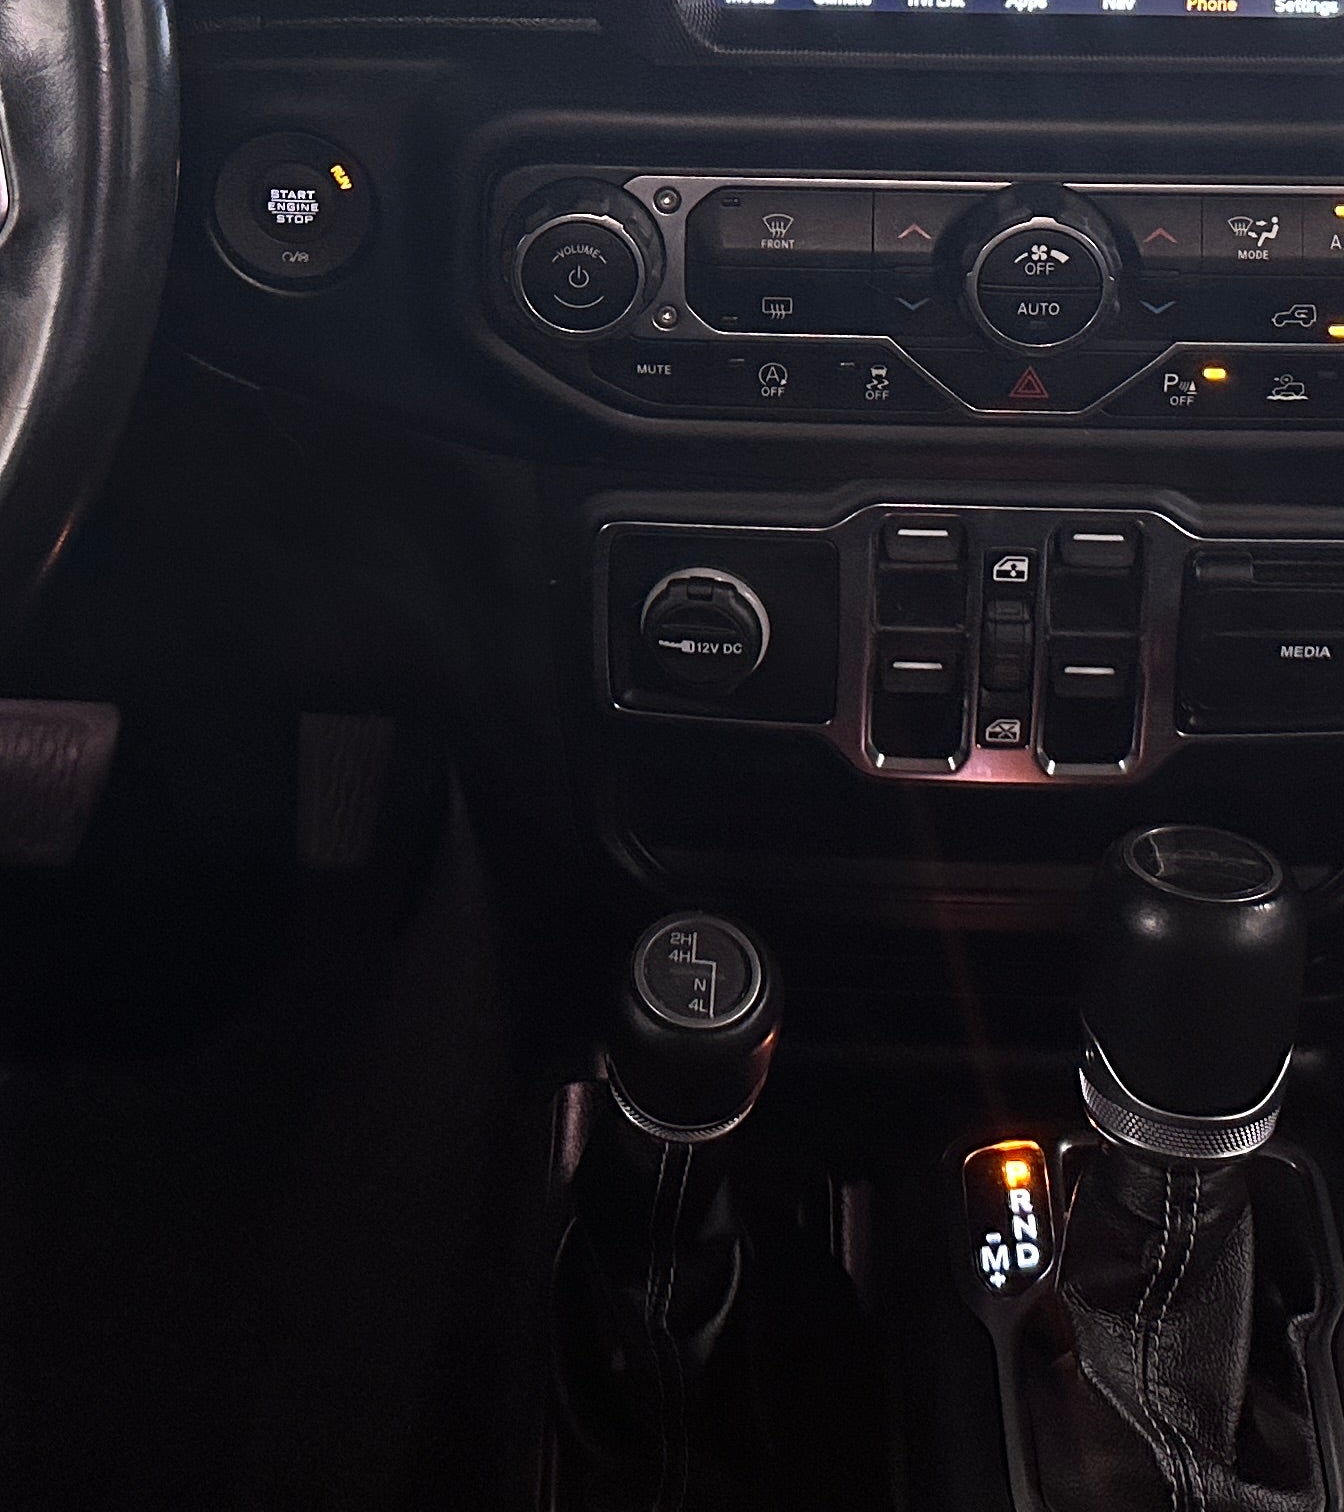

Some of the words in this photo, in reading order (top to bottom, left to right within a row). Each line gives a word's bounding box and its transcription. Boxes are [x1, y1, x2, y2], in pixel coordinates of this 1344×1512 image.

[270, 189, 316, 200] START
[267, 201, 319, 212] ENGINE
[276, 214, 314, 224] STOP
[761, 239, 795, 249] FRONT
[557, 244, 601, 259] VOLUME
[1237, 249, 1269, 261] MODE
[1024, 262, 1056, 276] OFF
[1017, 302, 1060, 316] AUTO
[636, 363, 672, 375] MUTE
[1163, 373, 1179, 393] P
[760, 386, 785, 398] OFF
[865, 390, 890, 401] OFF
[1170, 396, 1195, 407] OFF
[696, 642, 720, 655] 12V
[723, 642, 743, 655] DC
[1280, 645, 1331, 659] MEDIA
[670, 932, 692, 946] 2H
[668, 949, 691, 963] 4H
[694, 978, 706, 992] N
[688, 998, 708, 1013] 4L
[1005, 1160, 1031, 1188] P
[1010, 1188, 1033, 1214] R
[1013, 1214, 1038, 1241] N
[981, 1244, 1009, 1272] M
[1016, 1242, 1040, 1269] D
